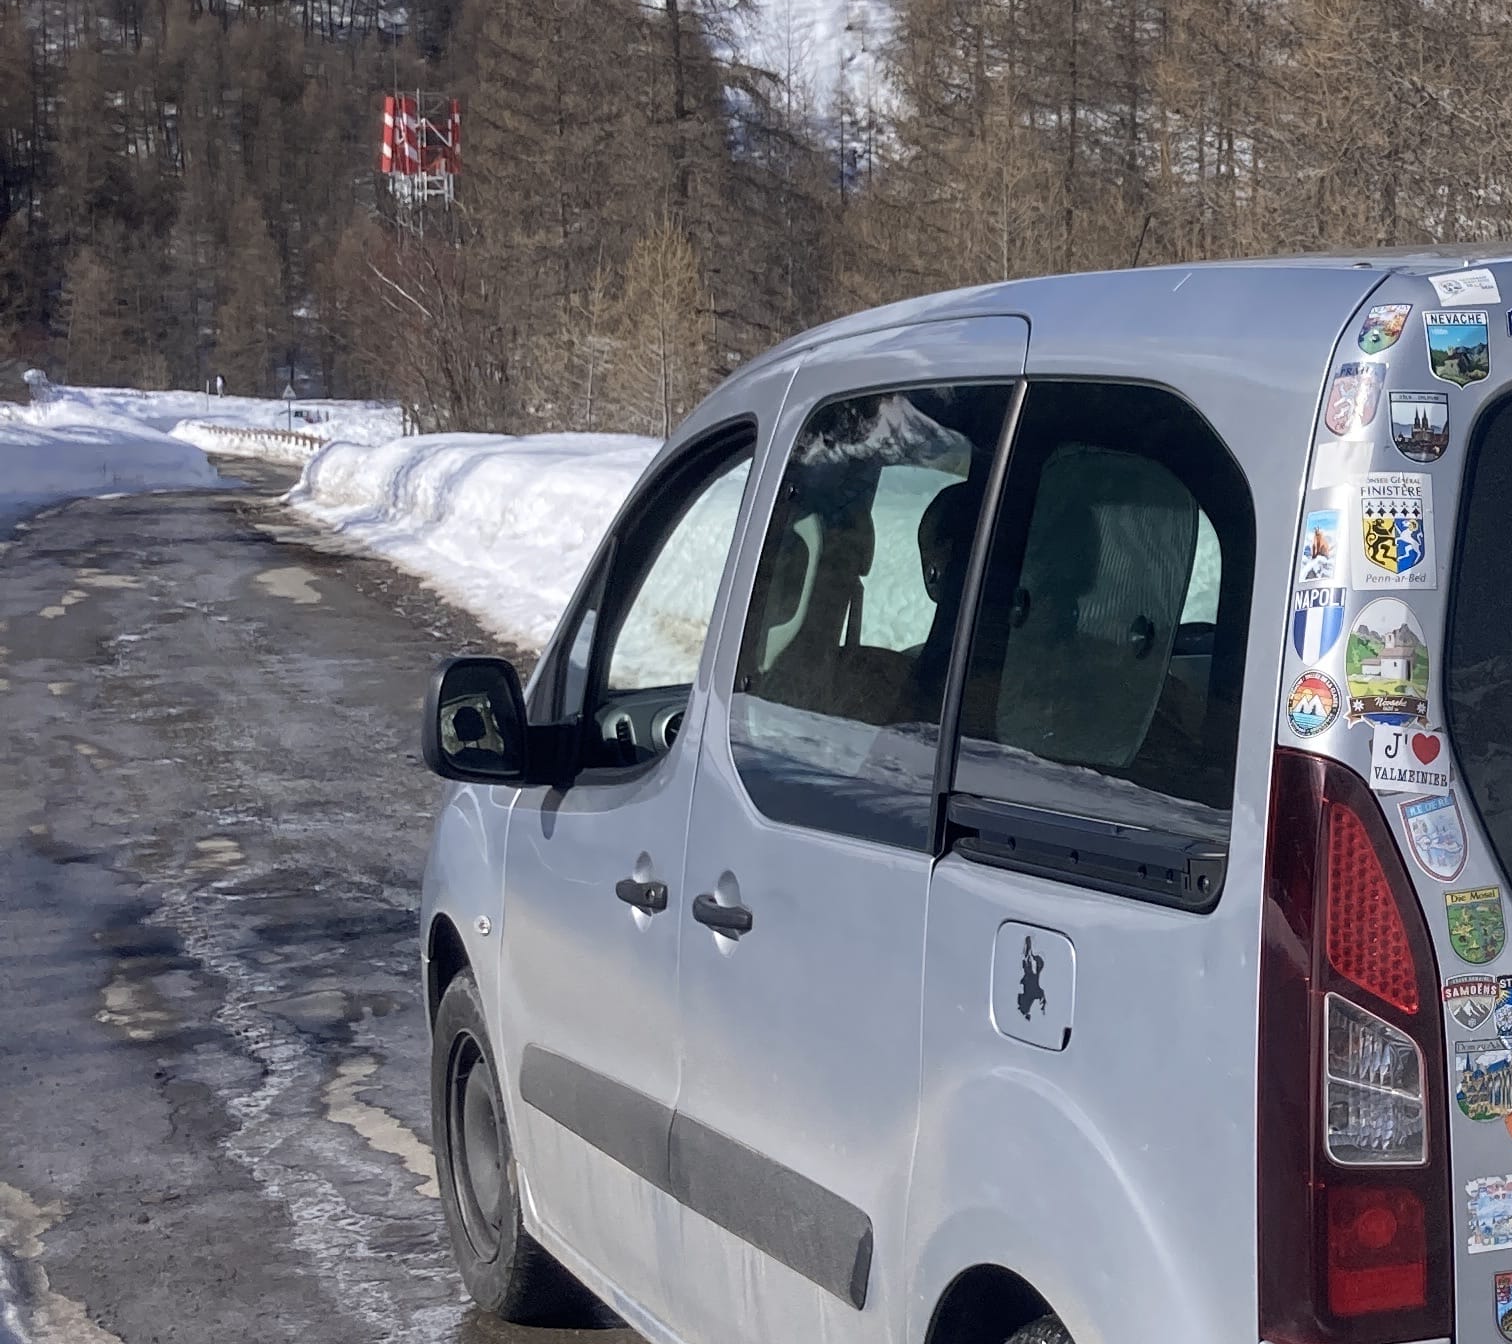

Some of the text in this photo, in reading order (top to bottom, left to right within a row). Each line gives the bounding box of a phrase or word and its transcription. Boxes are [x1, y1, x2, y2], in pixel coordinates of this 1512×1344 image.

[1430, 314, 1483, 325] NEVACHE
[1360, 484, 1422, 497] FINISTÈRE
[1366, 574, 1426, 584] Penn-ar-Bed
[1295, 588, 1345, 609] NAPOLI
[1374, 766, 1448, 787] VALMEINIER
[1499, 978, 1512, 989] ST
